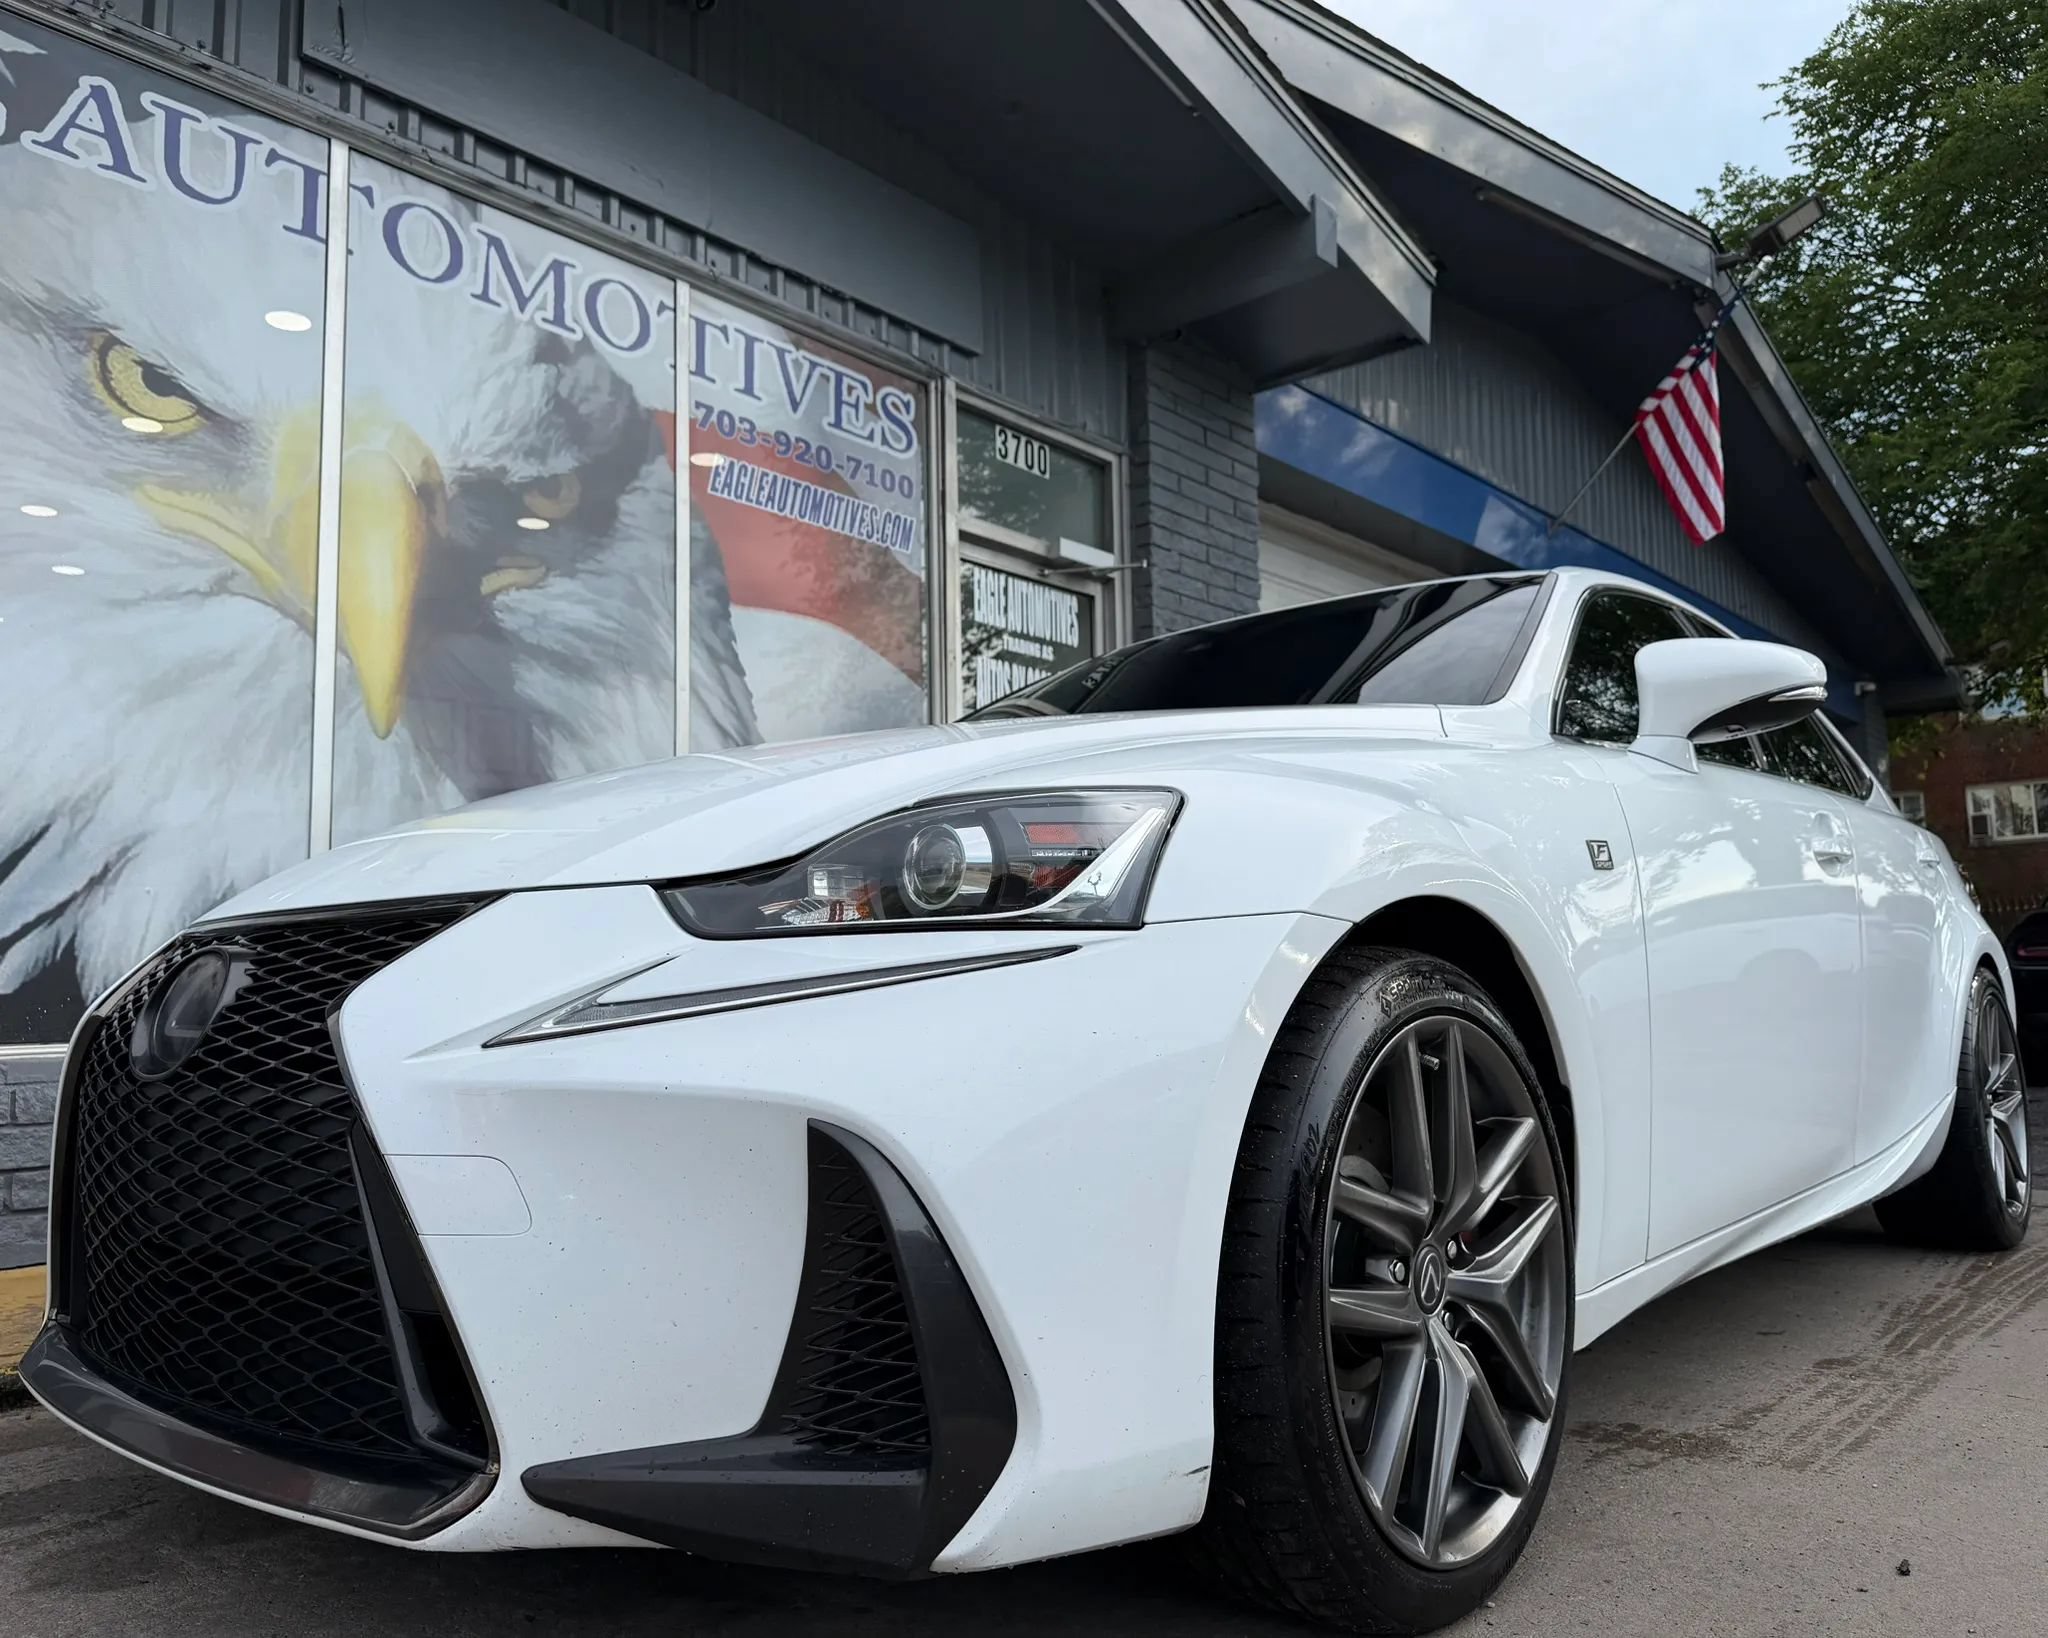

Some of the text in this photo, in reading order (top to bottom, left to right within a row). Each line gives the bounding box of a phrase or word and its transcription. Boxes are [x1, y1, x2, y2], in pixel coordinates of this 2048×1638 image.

[28, 81, 917, 455] AUTOMOTIVES
[694, 400, 914, 499] 703-920-7100
[998, 428, 1047, 475] 3700
[709, 459, 915, 552] EAGLEAUTOMOTIVES.COM
[973, 566, 1079, 648] EAGLE AUTOMOTIVES
